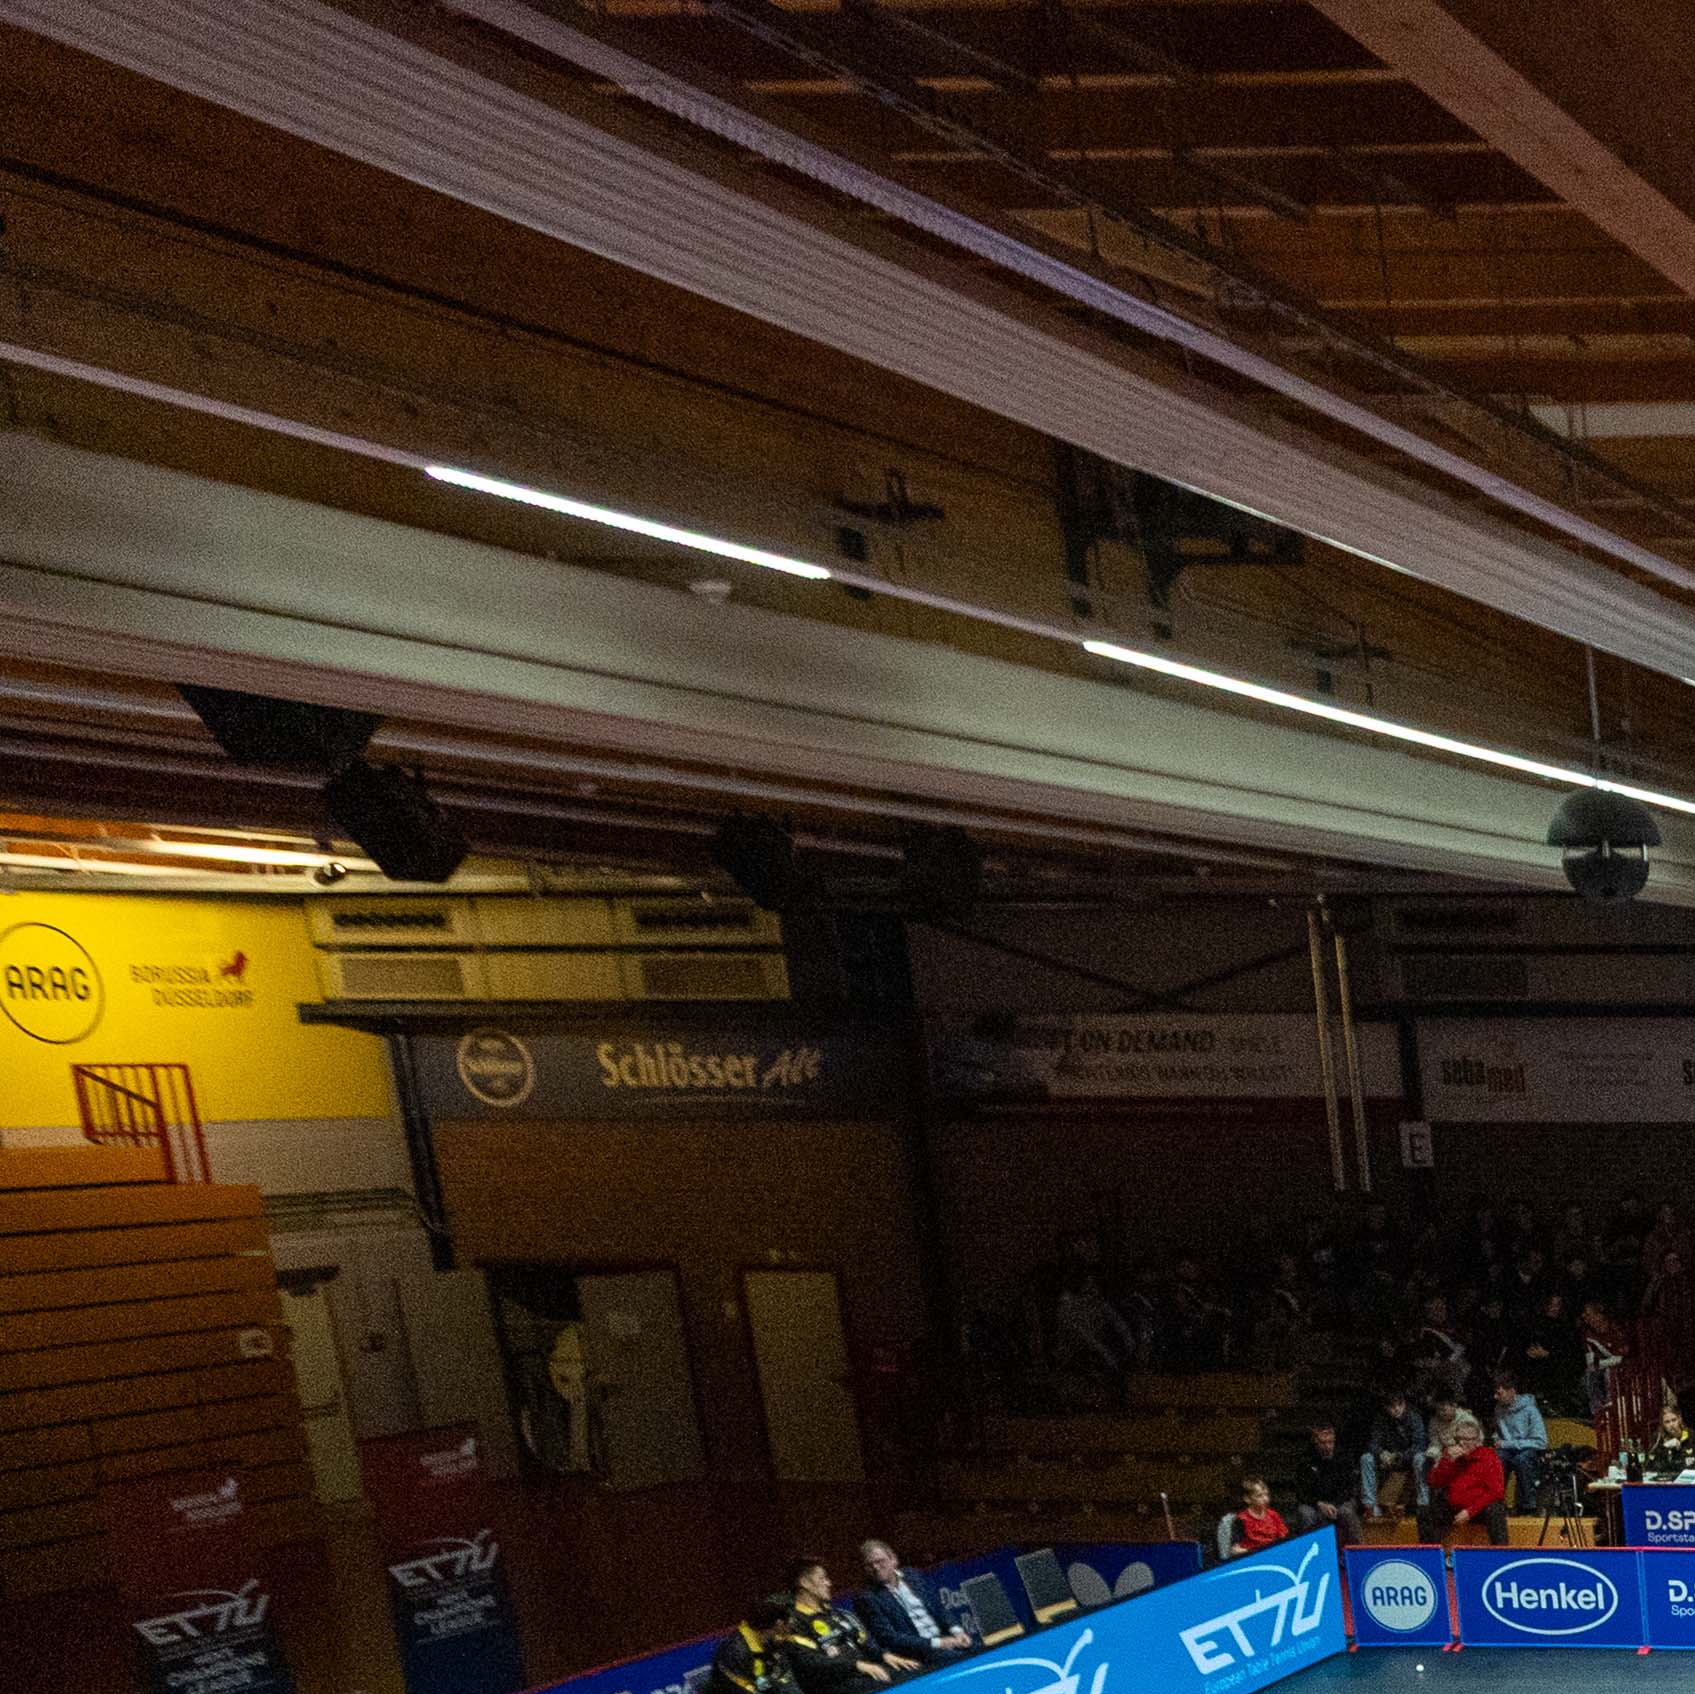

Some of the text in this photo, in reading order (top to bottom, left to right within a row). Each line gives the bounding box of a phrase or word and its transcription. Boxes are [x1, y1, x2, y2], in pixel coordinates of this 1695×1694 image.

[6, 964, 90, 1001] ARAG
[597, 1041, 759, 1090] Schlösser
[1409, 1132, 1428, 1164] E
[1371, 1585, 1428, 1607] ARAG
[1494, 1580, 1606, 1611] Henkel
[1178, 1572, 1331, 1676] ETTU
